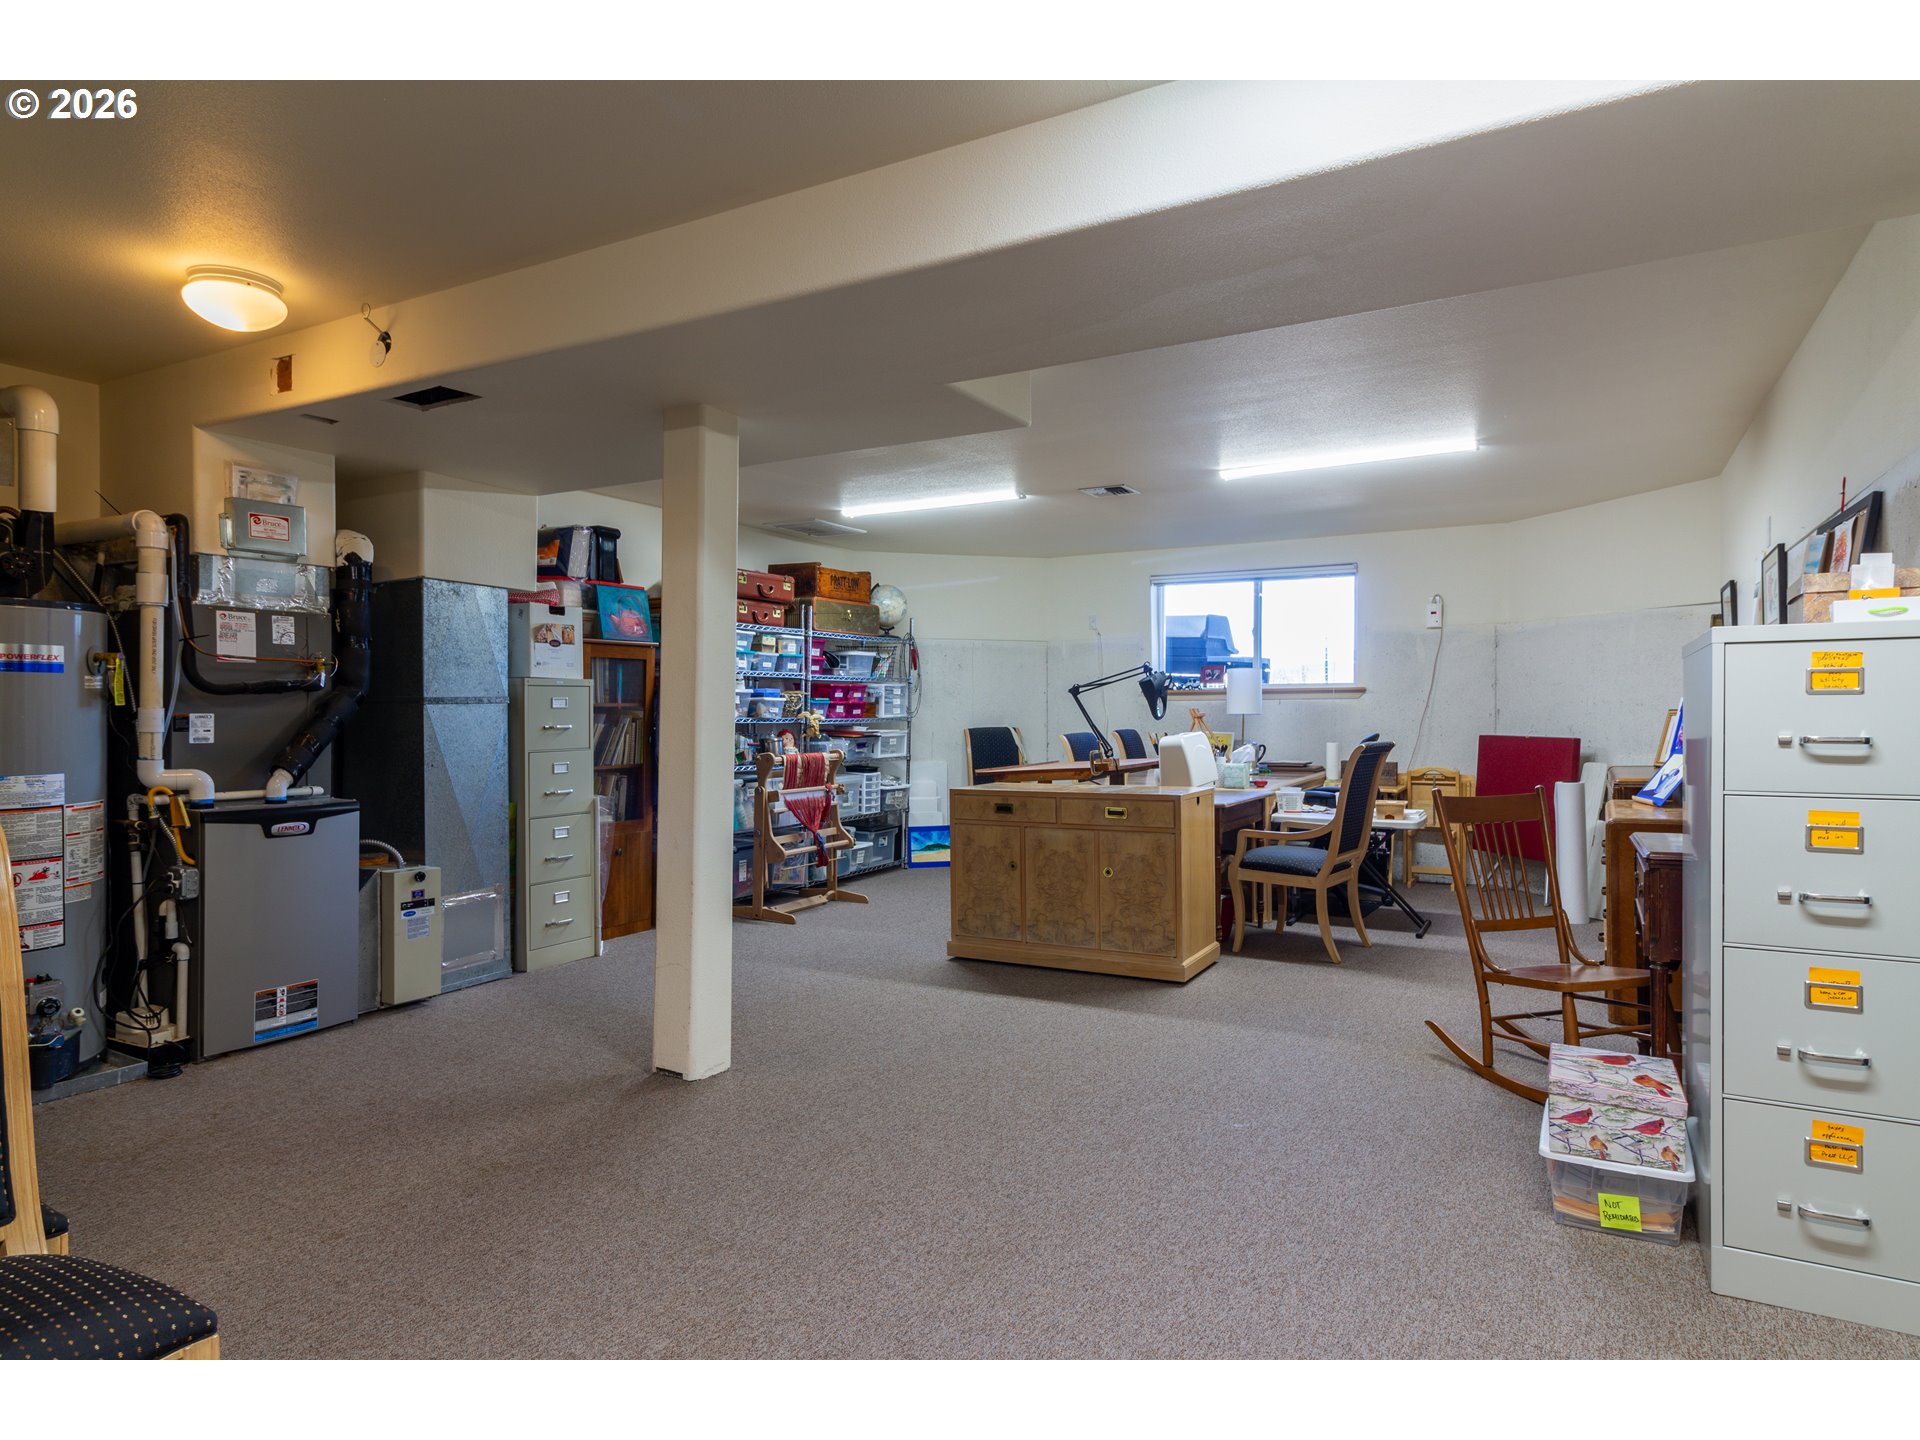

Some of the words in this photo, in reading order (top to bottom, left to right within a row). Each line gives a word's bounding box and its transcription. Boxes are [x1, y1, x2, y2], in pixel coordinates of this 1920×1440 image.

[262, 519, 282, 528] Bruce
[0, 653, 59, 661] POWERFLEX
[1604, 1199, 1623, 1209] NOT
